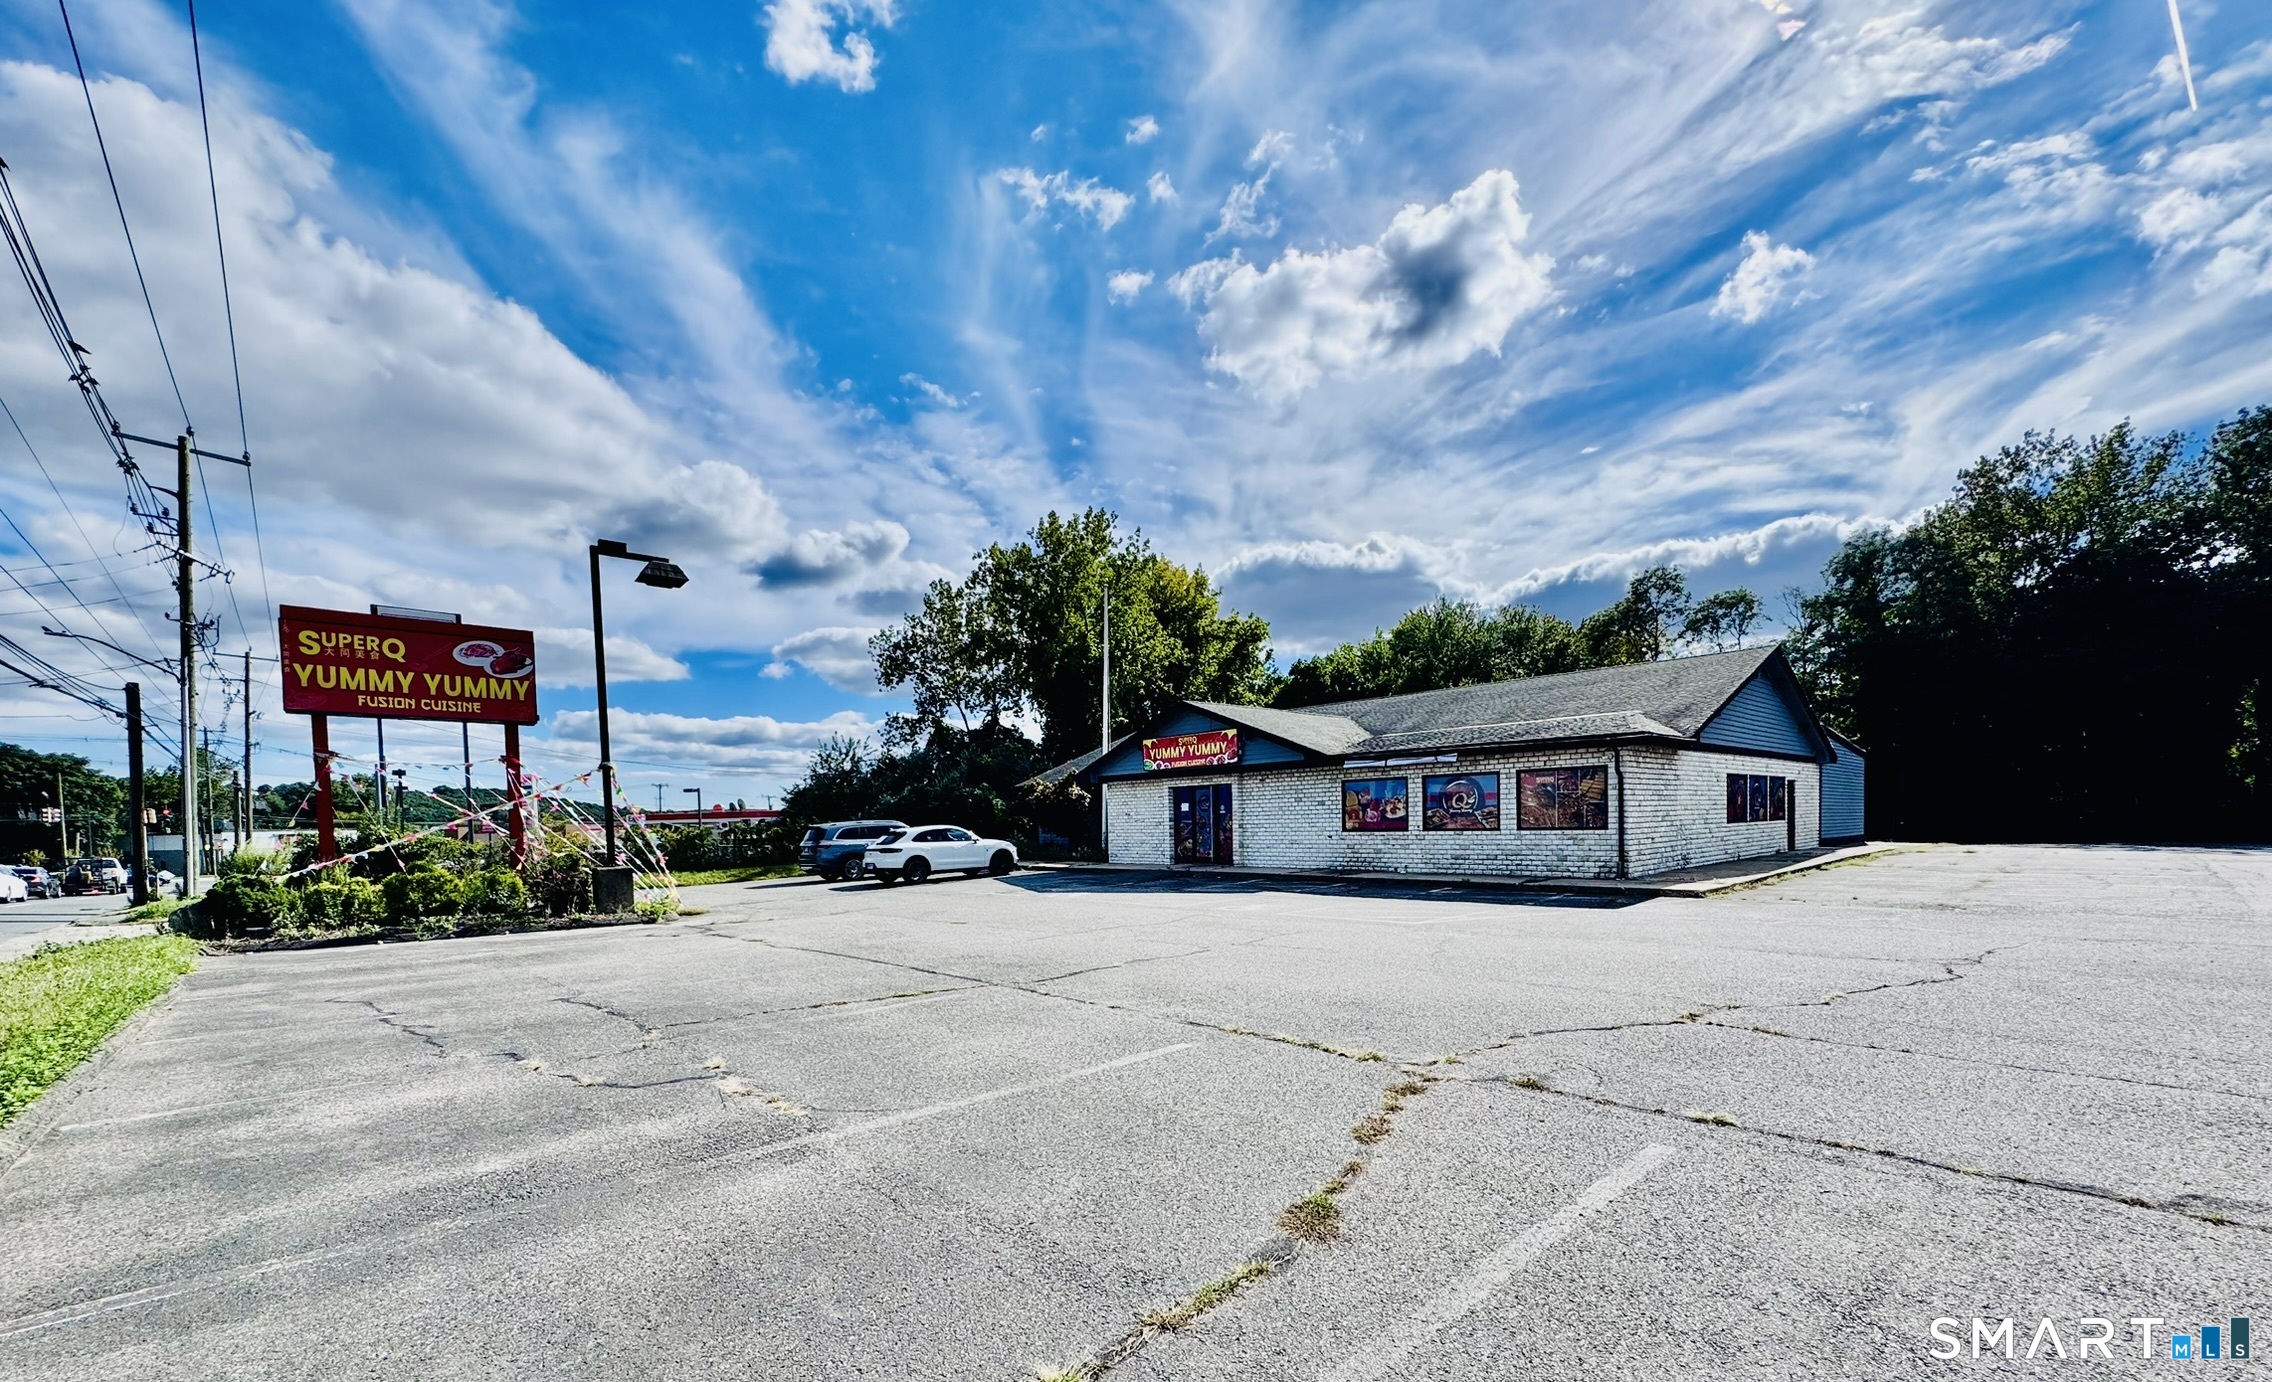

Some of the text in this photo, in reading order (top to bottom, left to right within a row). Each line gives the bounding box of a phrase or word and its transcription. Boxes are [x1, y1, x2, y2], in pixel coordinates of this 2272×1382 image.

[293, 663, 530, 701] YUMMY YUMMY
[357, 695, 482, 713] FUSION CUISINE
[1149, 746, 1187, 760] YUMMY
[1188, 741, 1228, 756] YUMMY
